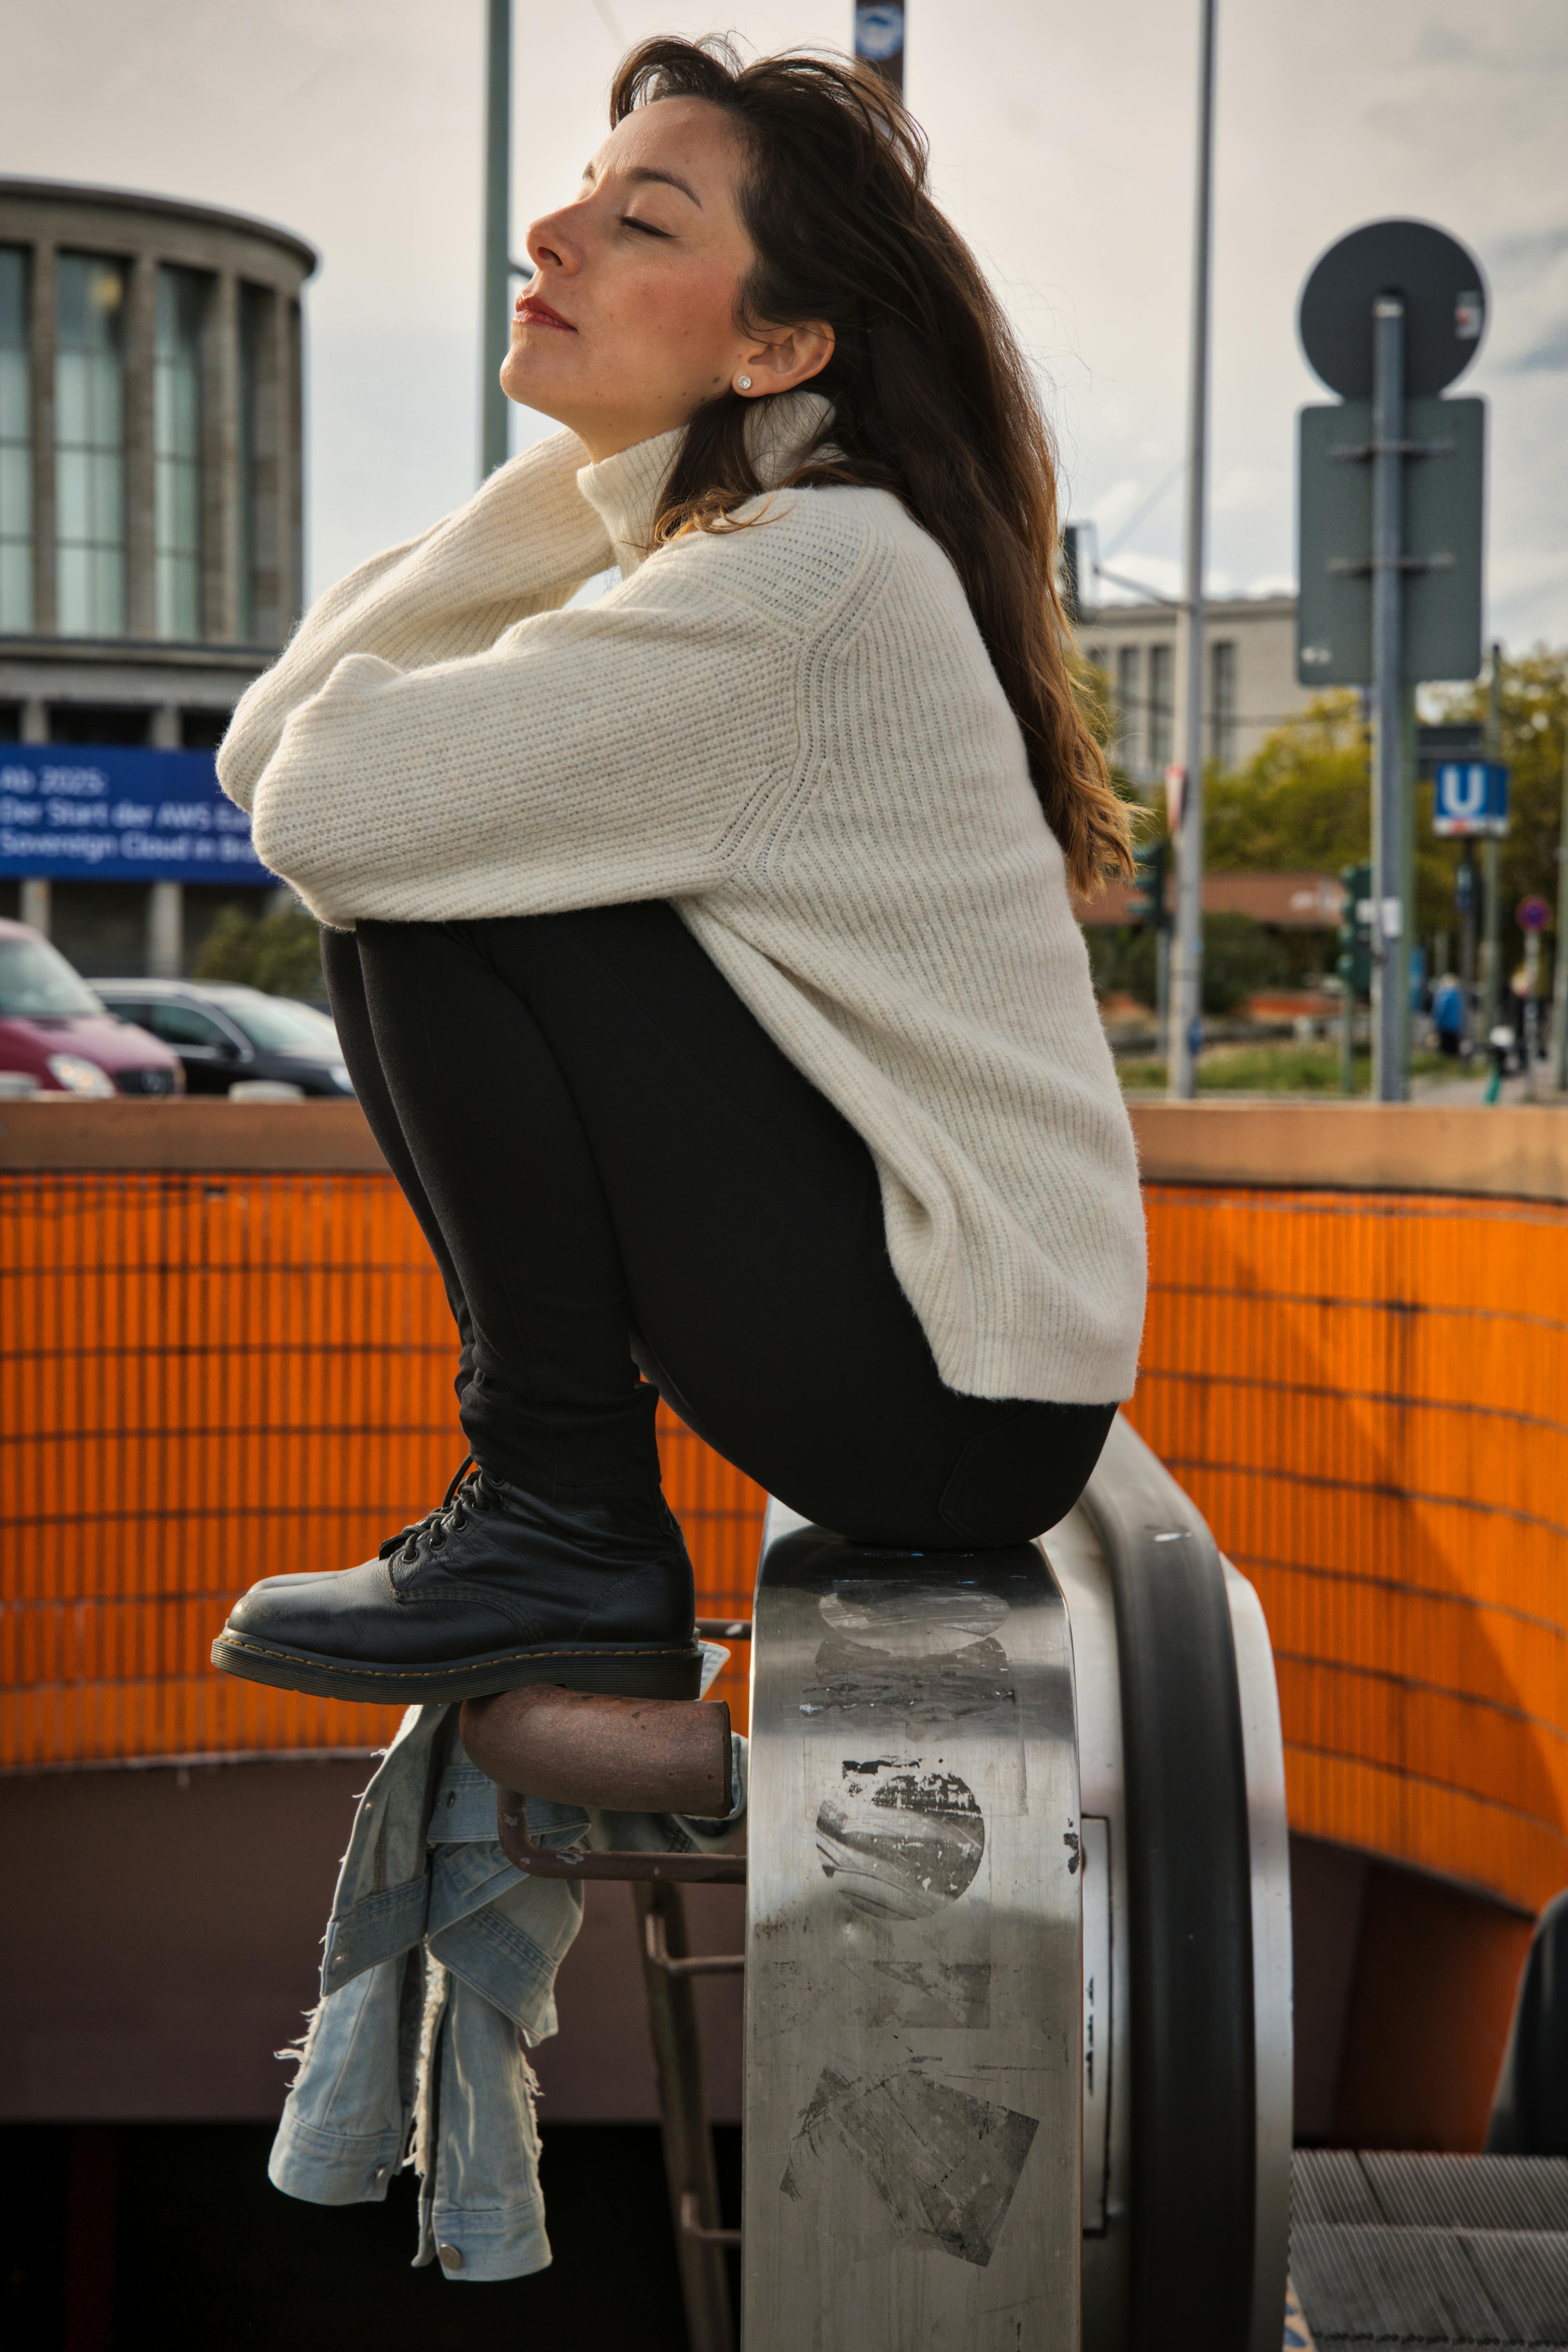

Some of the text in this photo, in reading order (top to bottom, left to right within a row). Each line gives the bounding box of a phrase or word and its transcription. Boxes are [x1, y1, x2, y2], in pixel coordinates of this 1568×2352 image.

[1441, 763, 1486, 817] U
[46, 798, 109, 826] Start
[112, 800, 152, 827] der
[157, 802, 211, 830] AWS
[0, 829, 118, 862] Sovereign
[122, 831, 190, 859] Cloud
[192, 834, 218, 859] in
